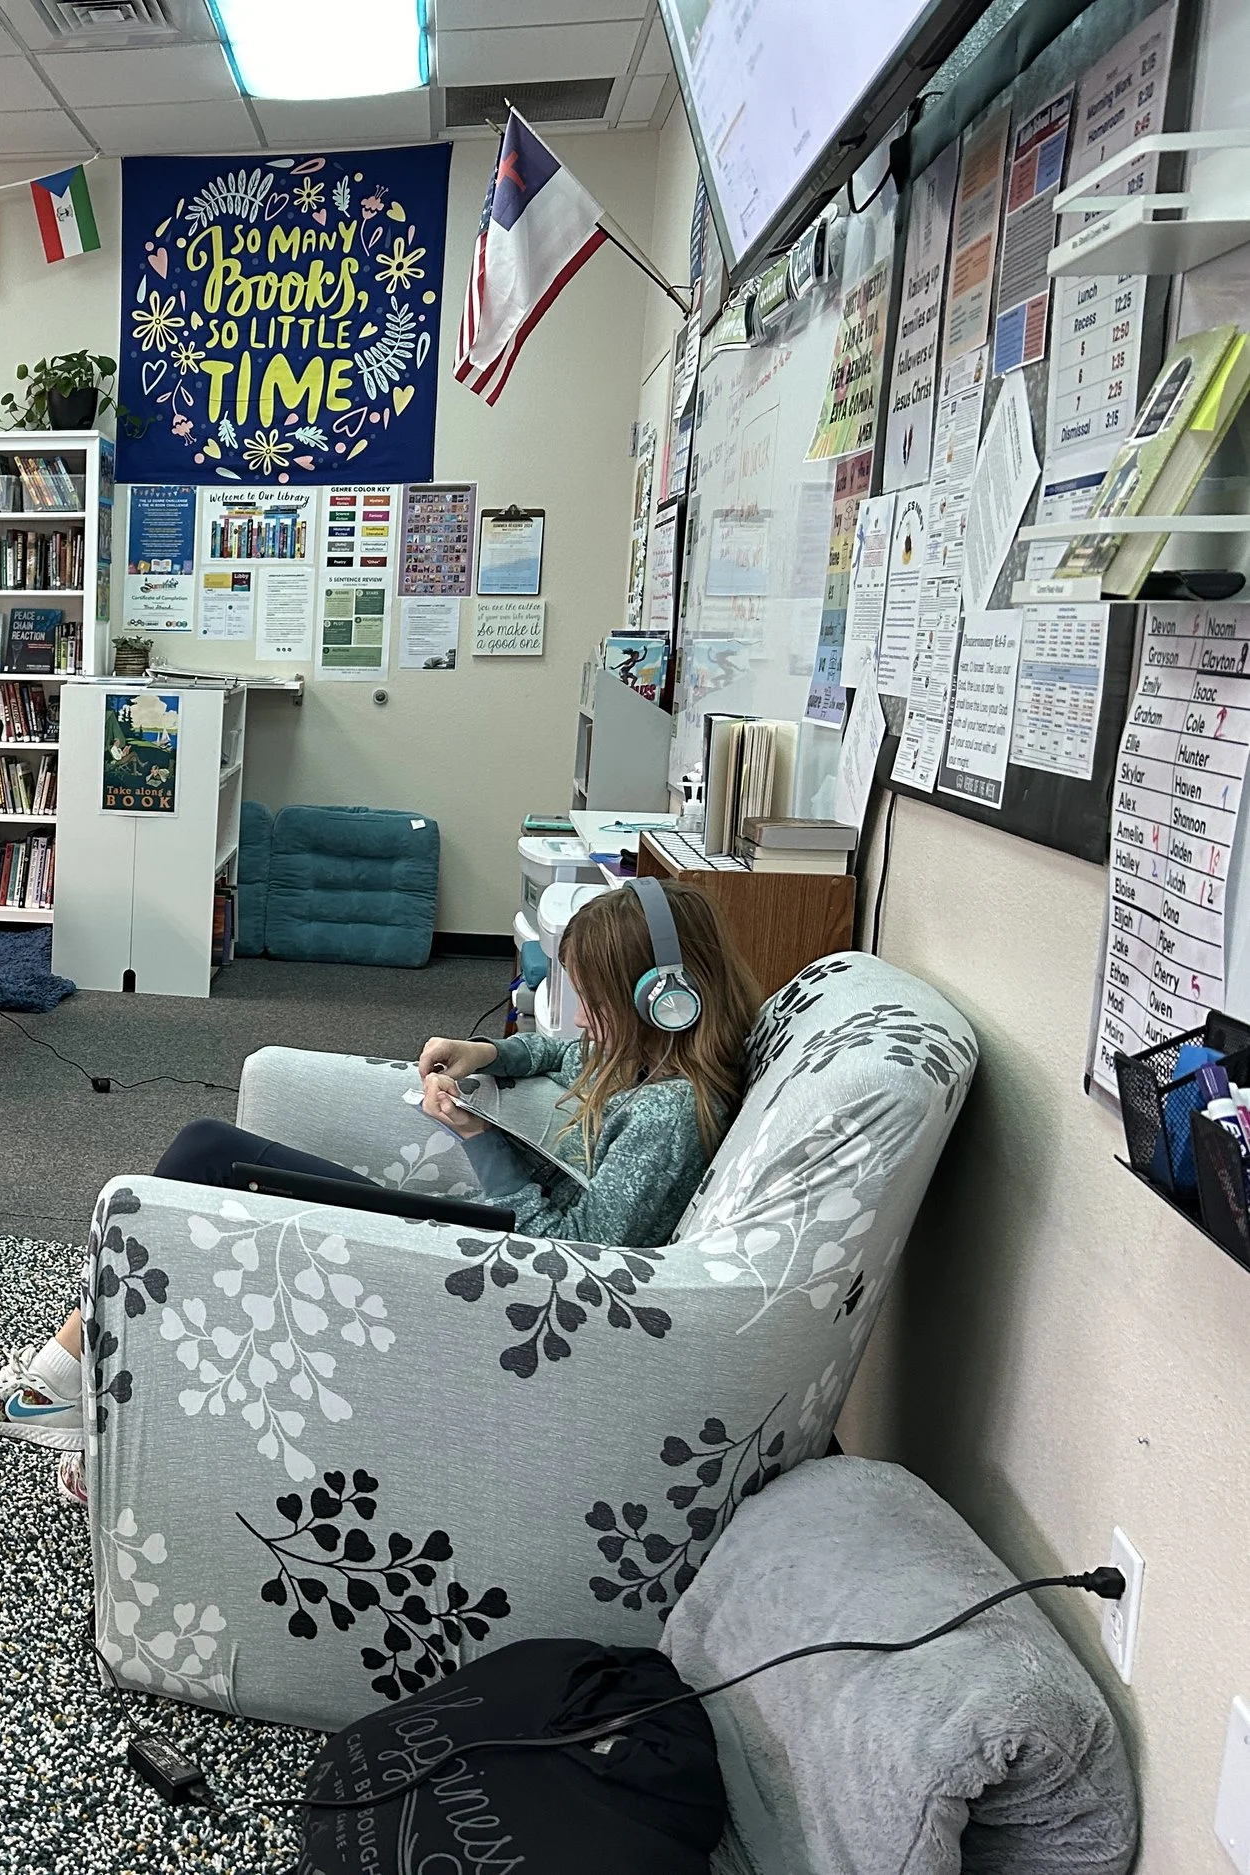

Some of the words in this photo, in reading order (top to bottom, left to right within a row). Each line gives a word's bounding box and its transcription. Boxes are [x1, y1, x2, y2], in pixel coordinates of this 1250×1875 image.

[231, 224, 261, 254] SO
[268, 220, 357, 263] MANY
[909, 275, 930, 299] Raising
[930, 264, 940, 288] up
[1077, 283, 1098, 305] Lunch
[901, 308, 926, 340] families
[925, 293, 939, 326] and
[1073, 312, 1097, 333] Recess
[1114, 291, 1132, 314] 12:25
[205, 319, 238, 348] SO
[250, 314, 352, 349] LITTLE
[1080, 341, 1085, 356] 5
[1112, 321, 1130, 343] 12:50
[897, 349, 927, 377] followers
[927, 333, 936, 359] of
[1078, 369, 1083, 384] 6
[1110, 352, 1125, 371] 1:35
[200, 351, 354, 428] TIME
[892, 391, 911, 414] Jesus
[911, 376, 932, 402] Christ
[1076, 397, 1081, 411] 7
[1108, 381, 1123, 400] 2:25
[1061, 419, 1091, 443] Dismissal
[1105, 410, 1119, 428] 3:15
[209, 492, 244, 503] Welcome
[247, 491, 256, 501] to
[258, 491, 275, 501] Our
[277, 491, 310, 508] Library
[12, 621, 34, 631] CHAIN
[14, 611, 36, 621] PEACE
[477, 621, 494, 637] So
[496, 622, 528, 636] make
[530, 621, 541, 636] it
[1151, 616, 1176, 635] Devon
[1207, 618, 1237, 637] Naomi
[11, 630, 46, 641] REACTION
[476, 639, 485, 649] a
[487, 637, 518, 654] good
[1148, 647, 1179, 668] Grayson
[1201, 653, 1236, 672] Clayton
[1141, 676, 1161, 694] Emily
[1193, 681, 1218, 702] Isaac
[1134, 707, 1163, 725] Graham
[1185, 715, 1205, 734] Cole
[1125, 733, 1141, 752] Ellie
[1178, 746, 1210, 767] Hunter
[106, 785, 132, 795] Take
[134, 787, 163, 797] along
[1121, 762, 1145, 784] Skylar
[1175, 776, 1202, 799] Haven
[106, 795, 171, 809] BOOK
[1118, 792, 1137, 812] Alex
[1173, 806, 1207, 834] Shannon
[1116, 824, 1144, 844] Amelia
[1170, 841, 1193, 863] Jaiden
[1116, 850, 1140, 875] Hailey
[1166, 874, 1186, 894] Judah
[1115, 878, 1136, 901] Eloise
[1162, 900, 1180, 925] Oona
[1114, 905, 1133, 931] Elijah
[1159, 929, 1175, 956] Piper
[1112, 935, 1129, 957] Jake
[1154, 961, 1180, 994] Cherry
[1107, 990, 1125, 1015] Madi
[1110, 962, 1130, 987] Ethan
[1149, 992, 1173, 1019] Owen
[1104, 1017, 1125, 1044] Maira
[347, 1733, 368, 1775] CAN'T
